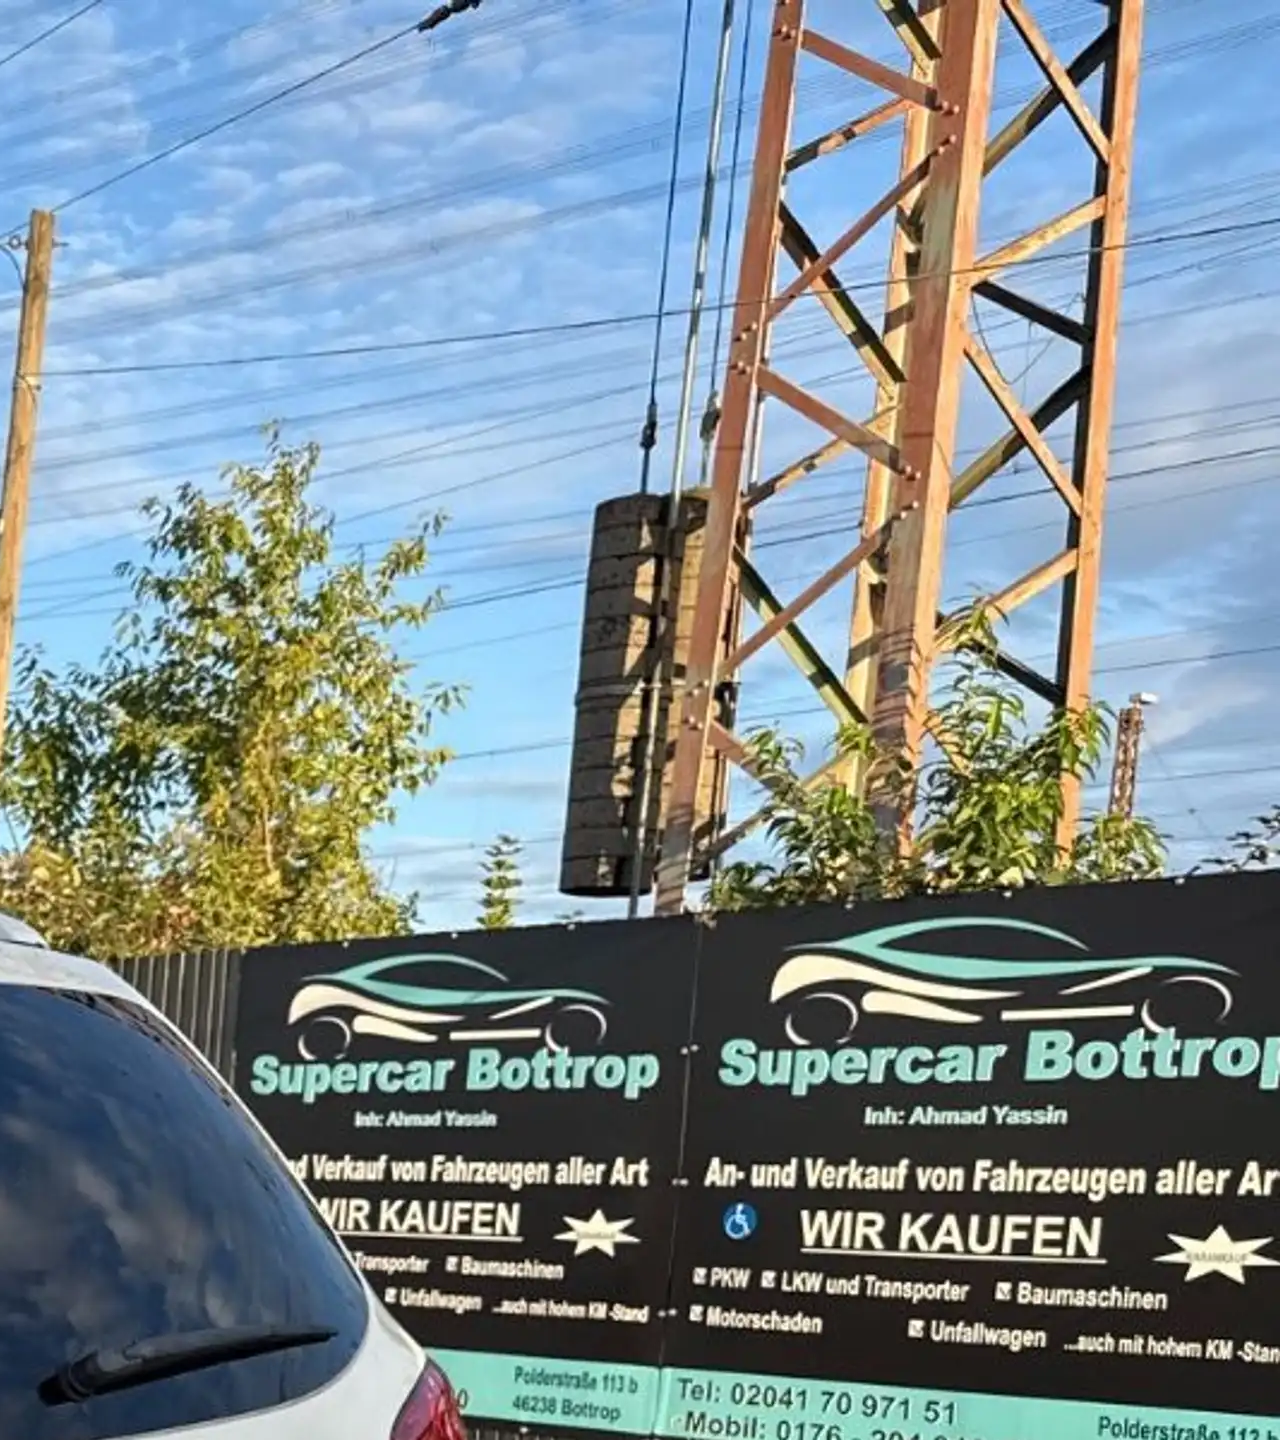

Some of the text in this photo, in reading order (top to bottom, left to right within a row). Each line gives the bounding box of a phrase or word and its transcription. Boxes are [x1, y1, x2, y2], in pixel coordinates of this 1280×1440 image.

[250, 1047, 659, 1103] Supercar Bottrop
[718, 1038, 1007, 1095] Supercar
[386, 1110, 441, 1127] Ahmad
[445, 1109, 498, 1127] Yassin
[864, 1105, 1068, 1125] Inh: Ahmad Yassin
[290, 1154, 649, 1191] nd Verkauf von Fahrzeugen aller Art
[704, 1157, 1280, 1202] An- und Verkauf von Fahrzeugen aller Ar
[318, 1197, 521, 1236] WIR KAUFEN
[800, 1210, 1101, 1256] WIR KAUFEN
[354, 1251, 430, 1275] Transporter
[461, 1256, 565, 1280] Baumaschinen
[710, 1267, 750, 1289] PKW
[781, 1271, 971, 1303] LKW und Transporter
[400, 1288, 482, 1314] Unfallwagen
[1017, 1282, 1168, 1310] Baumaschinen
[706, 1306, 823, 1333] Motorschaden
[930, 1321, 1046, 1351] Unfallwagen
[1118, 1336, 1145, 1355] mit
[1146, 1337, 1202, 1359] hohem
[1205, 1339, 1234, 1360] KM
[1236, 1341, 1280, 1364] -Stan
[514, 1365, 638, 1394] Polderstraße 113 b
[512, 1395, 621, 1423] 46238 Bottrop
[677, 1378, 956, 1426] Tel: 02041 70 971 51
[684, 1411, 766, 1439] Mobil:
